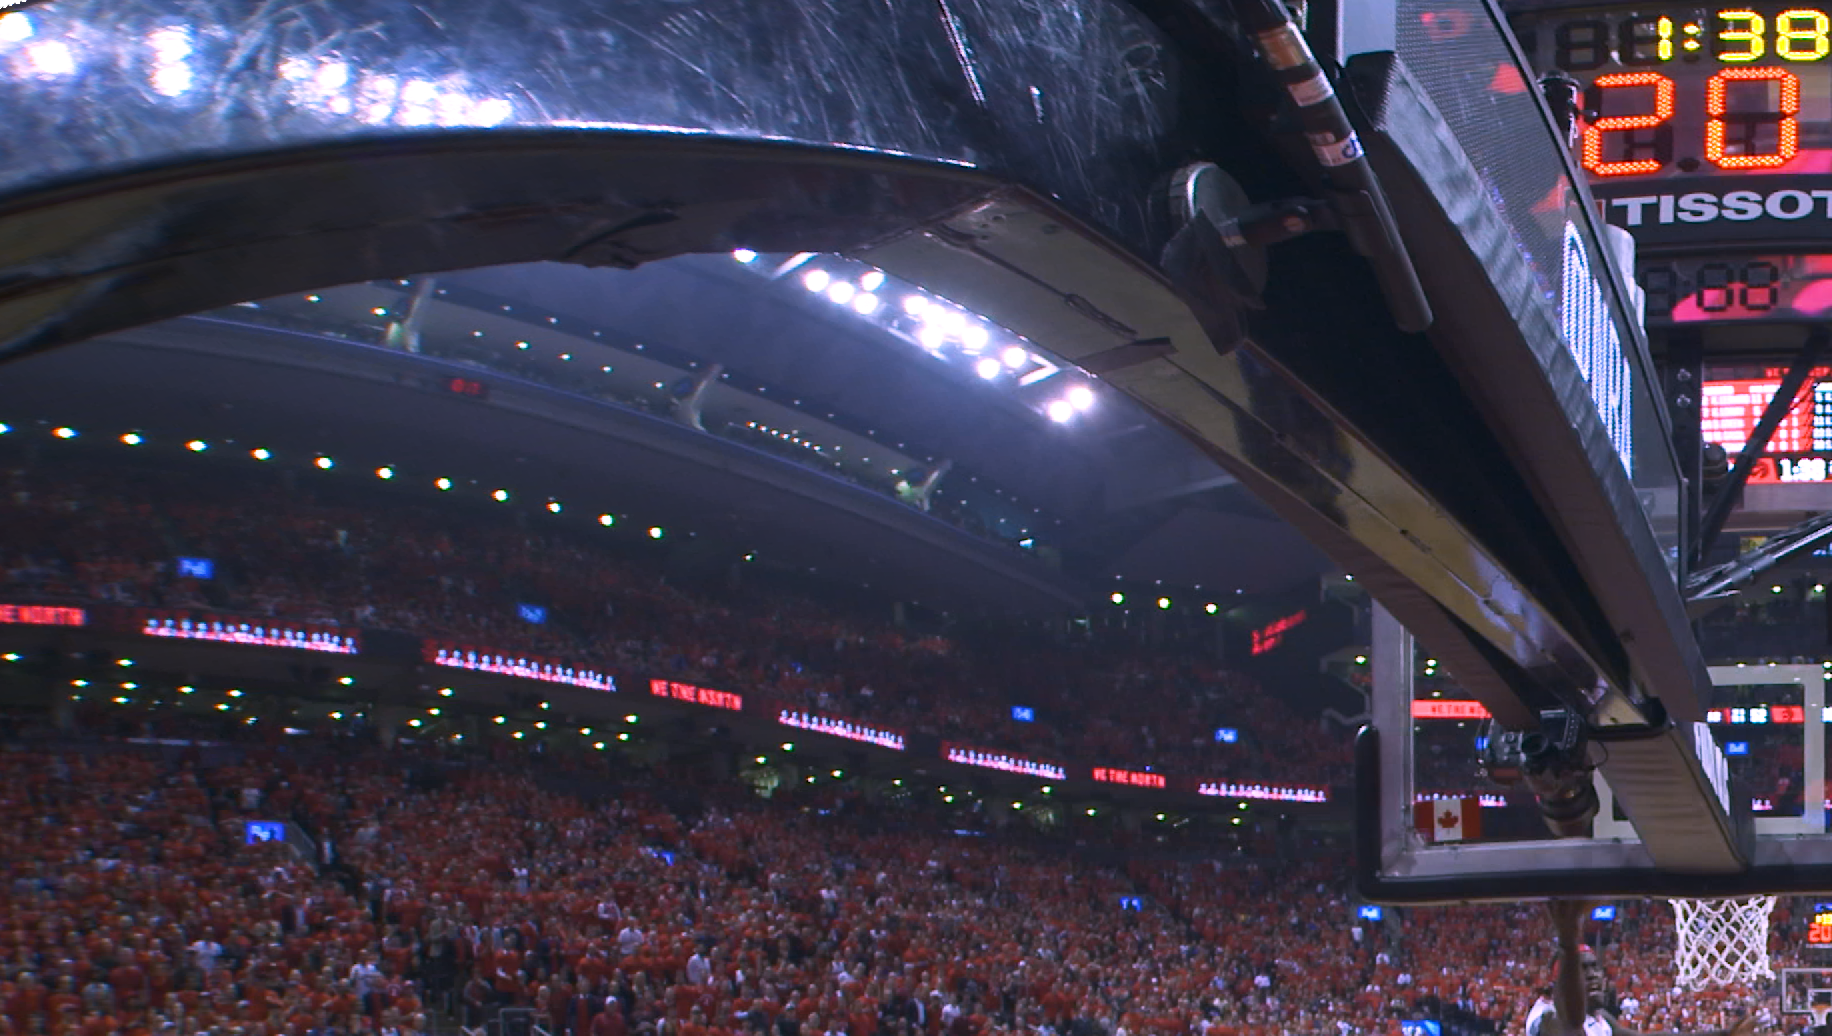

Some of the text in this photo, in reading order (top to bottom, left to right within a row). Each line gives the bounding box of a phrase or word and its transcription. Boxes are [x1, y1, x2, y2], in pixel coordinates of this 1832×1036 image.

[1658, 9, 1830, 61] 1:38
[1582, 66, 1800, 176] 20
[1807, 922, 1832, 944] 20
